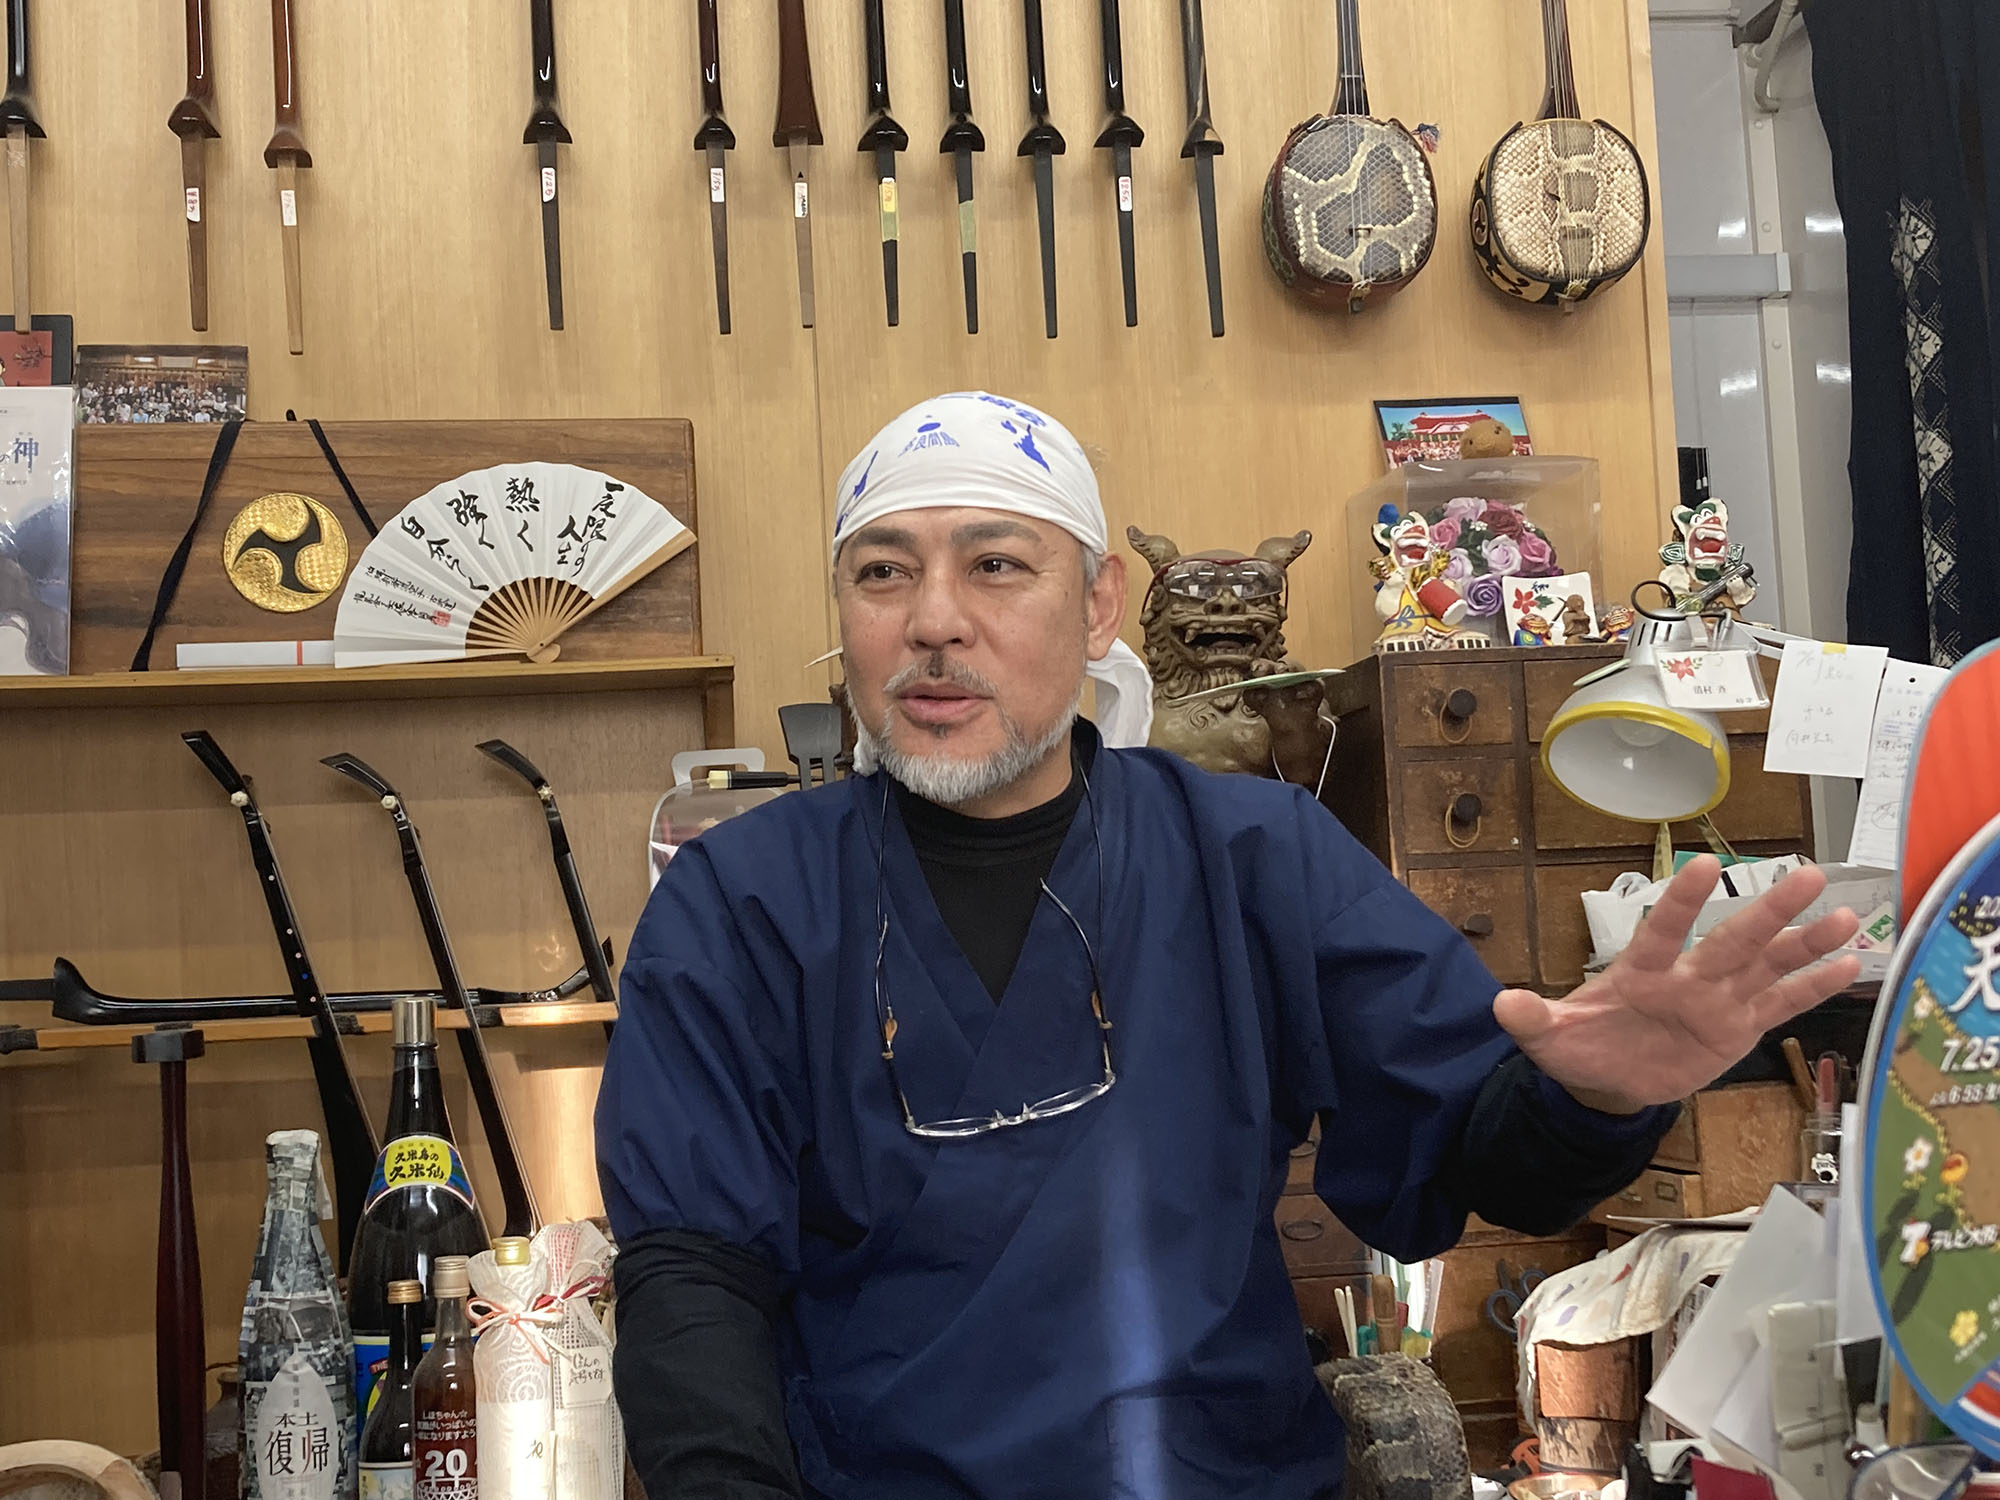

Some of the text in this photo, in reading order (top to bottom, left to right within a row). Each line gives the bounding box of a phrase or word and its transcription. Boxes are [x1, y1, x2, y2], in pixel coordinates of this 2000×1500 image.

[505, 477, 540, 552] 熱く
[395, 1148, 439, 1164] 久米島の
[389, 1163, 445, 1182] 久米仙
[275, 1412, 319, 1428] 本土
[265, 1427, 330, 1476] 復帰
[425, 1449, 467, 1477] 20
